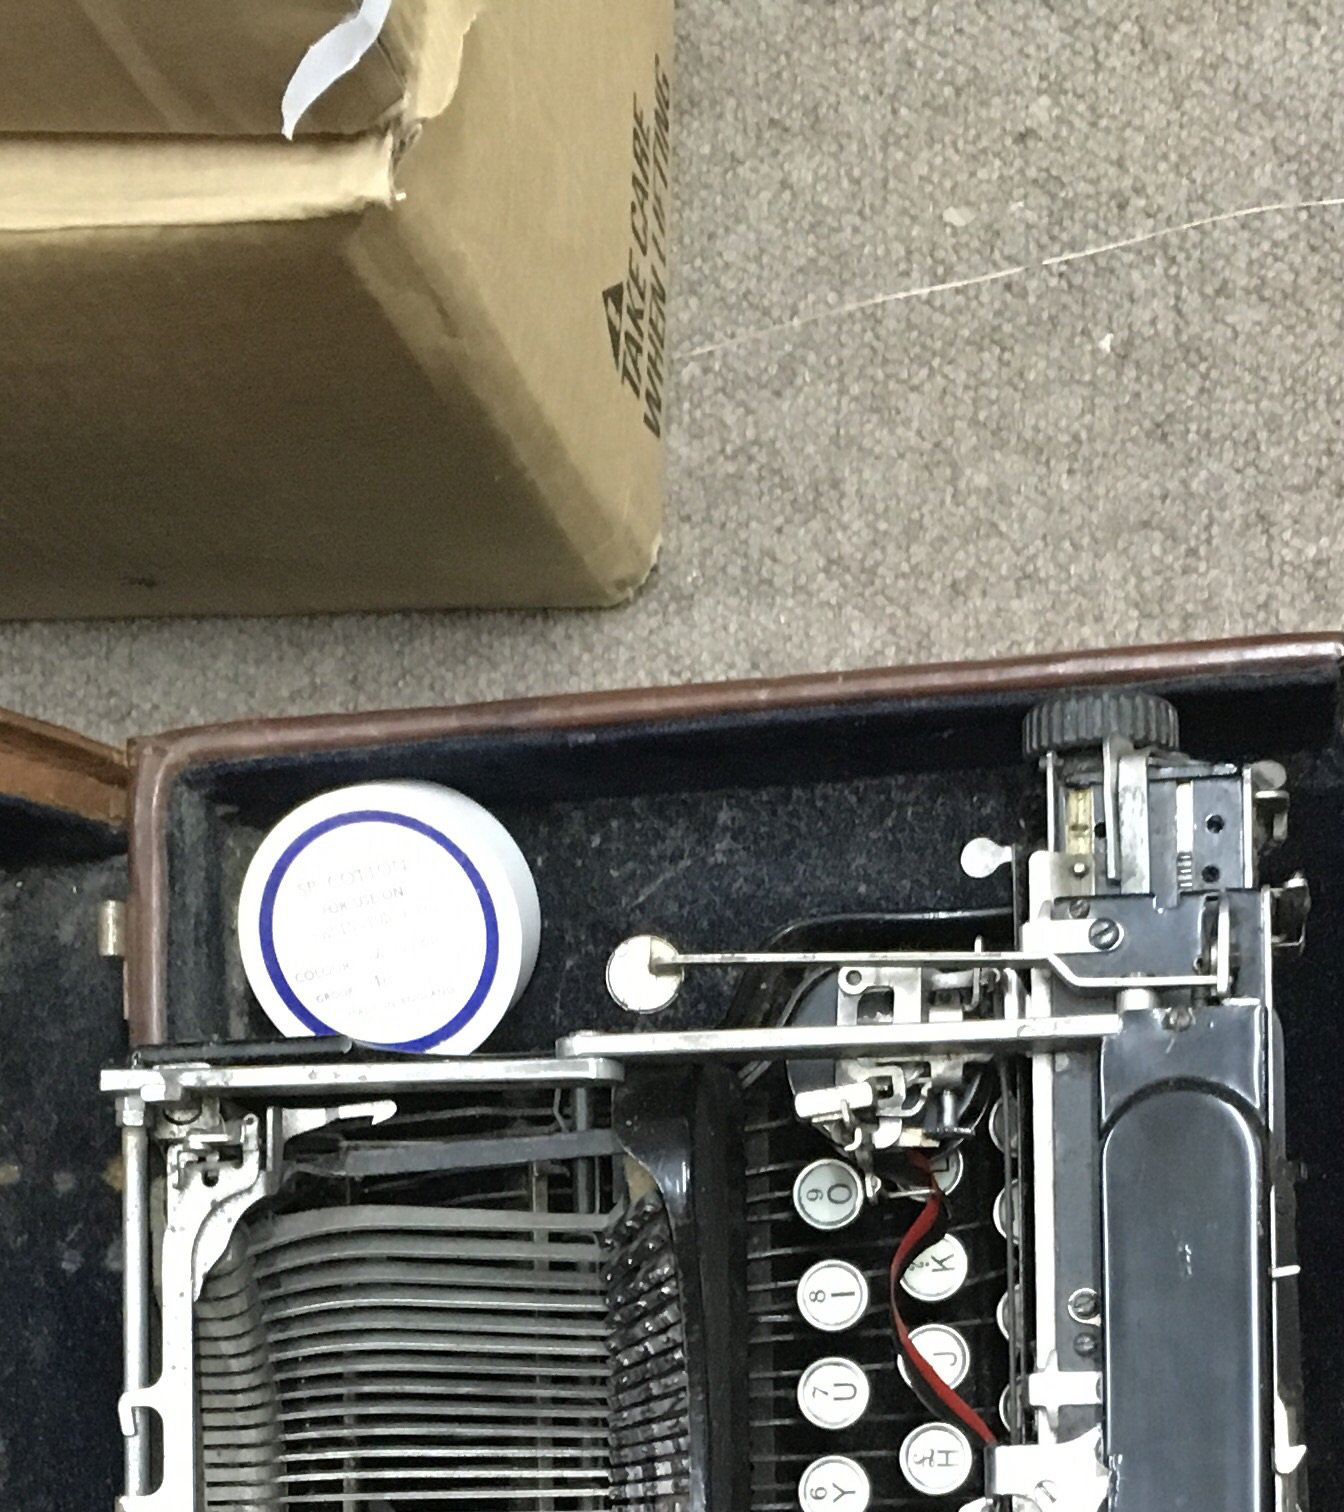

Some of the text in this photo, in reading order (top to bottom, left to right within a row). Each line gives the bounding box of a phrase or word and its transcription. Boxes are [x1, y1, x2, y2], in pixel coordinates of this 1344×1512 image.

[621, 91, 650, 400] TAKE CARE
[643, 53, 670, 438] WHEN LIFTING
[931, 1255, 955, 1272] K
[809, 1289, 826, 1304] 8
[932, 1351, 958, 1367] J
[812, 1386, 829, 1399] 7
[834, 1383, 857, 1401] U
[938, 1450, 959, 1468] H
[810, 1486, 828, 1501] 6
[832, 1482, 856, 1503] Y
